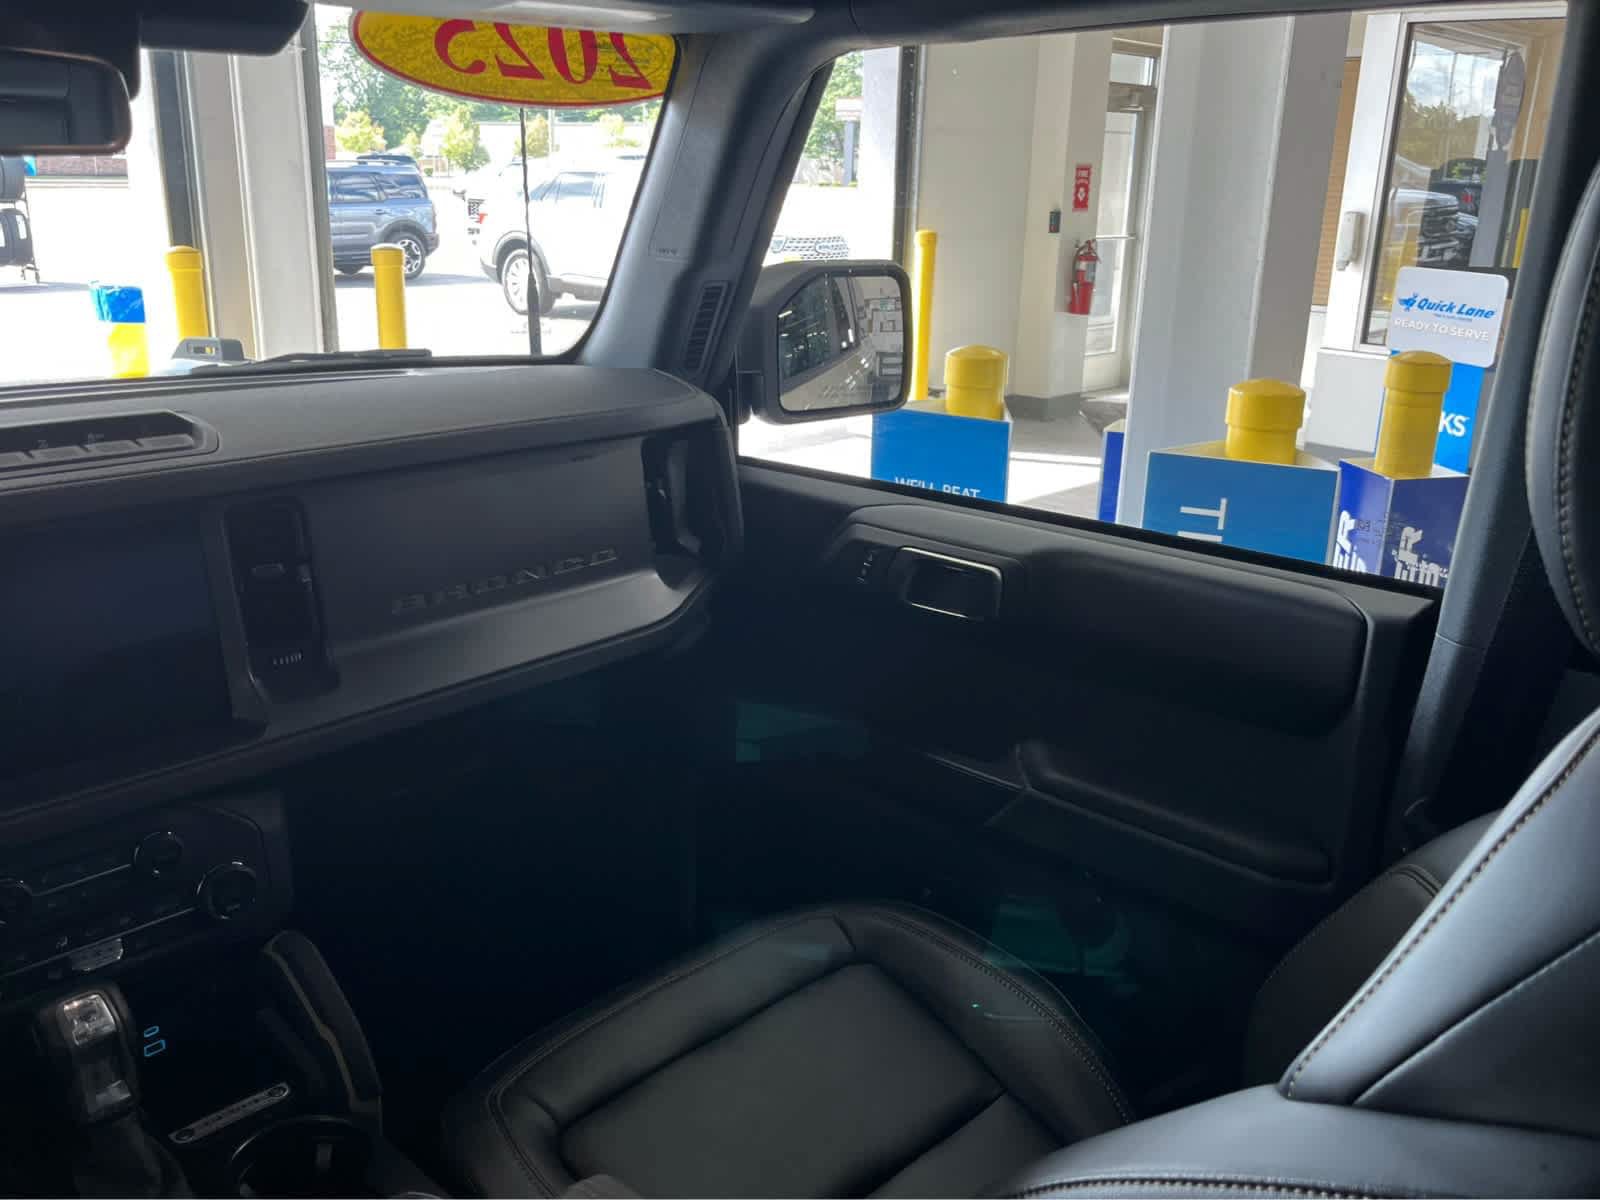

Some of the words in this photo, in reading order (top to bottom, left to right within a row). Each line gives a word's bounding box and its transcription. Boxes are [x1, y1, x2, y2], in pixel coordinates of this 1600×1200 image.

[1417, 297, 1456, 313] Quick
[1457, 303, 1497, 319] Lane
[1394, 318, 1429, 333] READY
[1432, 322, 1449, 335] TO
[1449, 327, 1489, 342] SERVE
[392, 548, 617, 615] BRONCO
